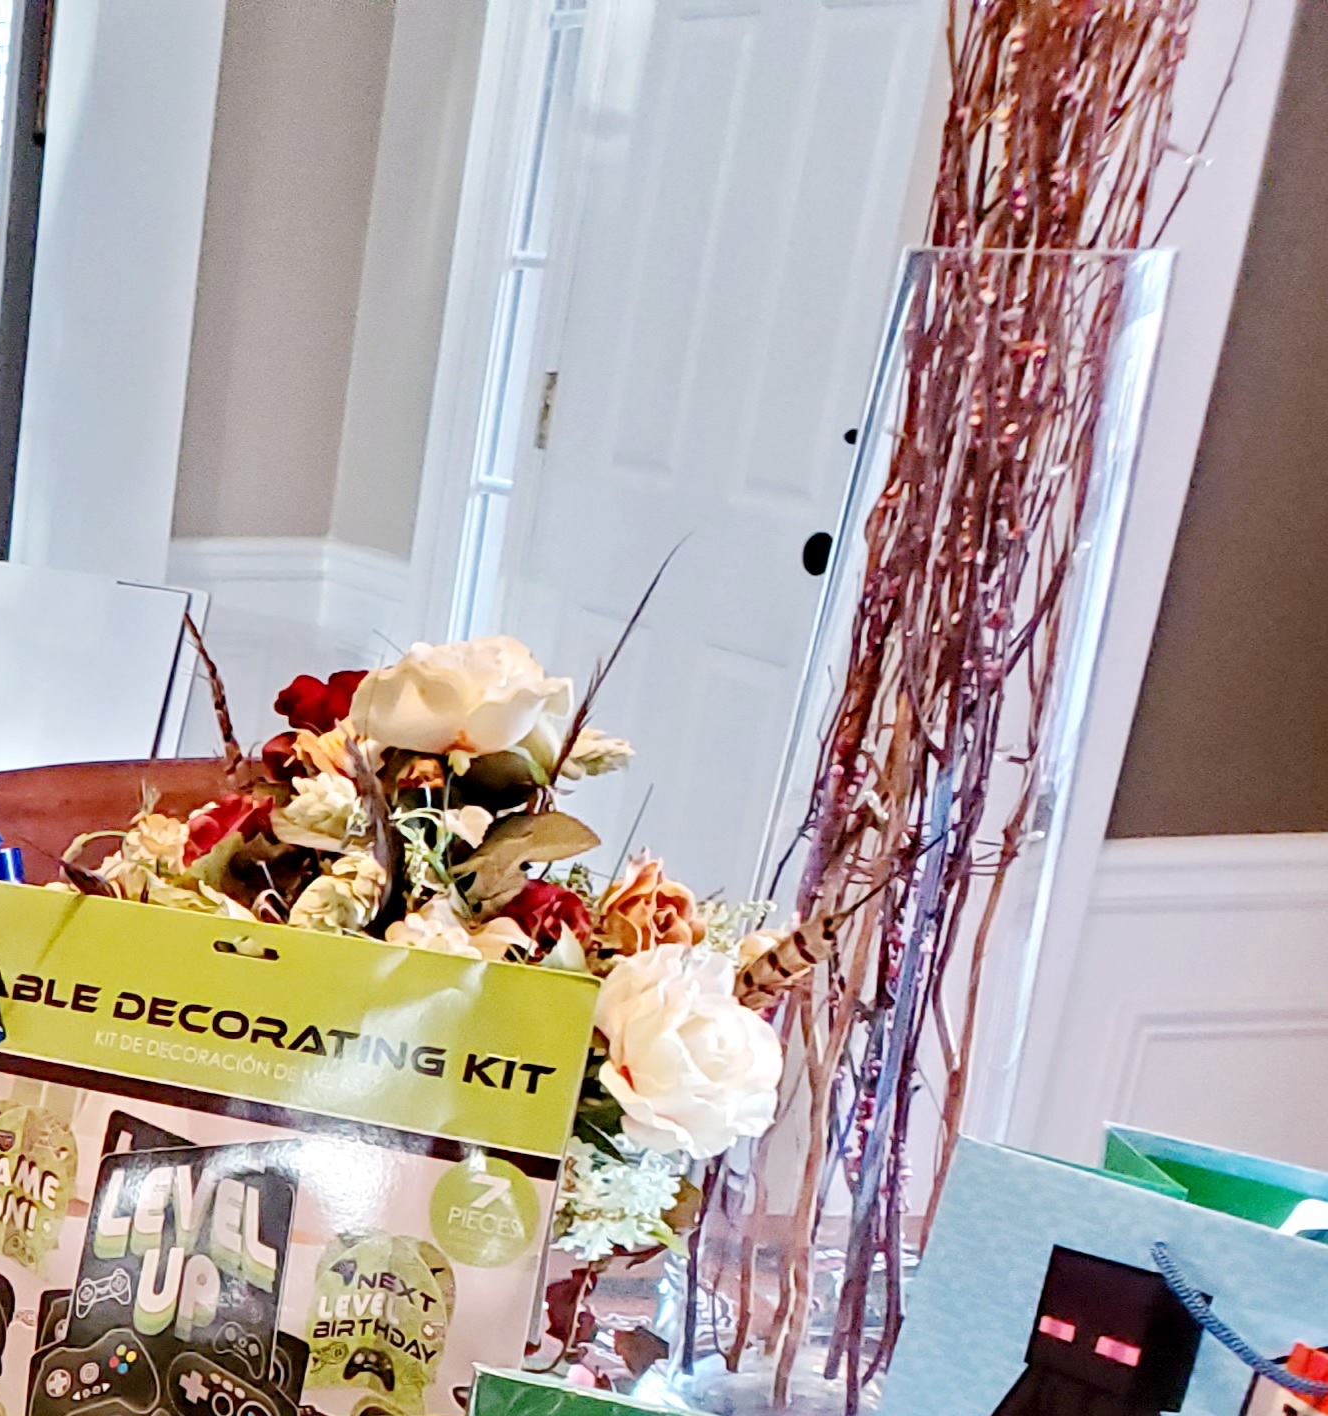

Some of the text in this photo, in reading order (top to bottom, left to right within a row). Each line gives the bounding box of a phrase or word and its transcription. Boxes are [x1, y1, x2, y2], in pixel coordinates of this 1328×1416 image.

[114, 990, 447, 1079] DECORATING
[462, 1053, 557, 1094] KIT
[470, 1174, 511, 1208] 7
[95, 1165, 277, 1285] LEVEL
[448, 1206, 522, 1239] PIECES
[134, 1247, 221, 1340] UP
[318, 1292, 400, 1326] LEVEL
[357, 1272, 437, 1313] NEXT
[313, 1318, 437, 1365] BIRTHDAY
